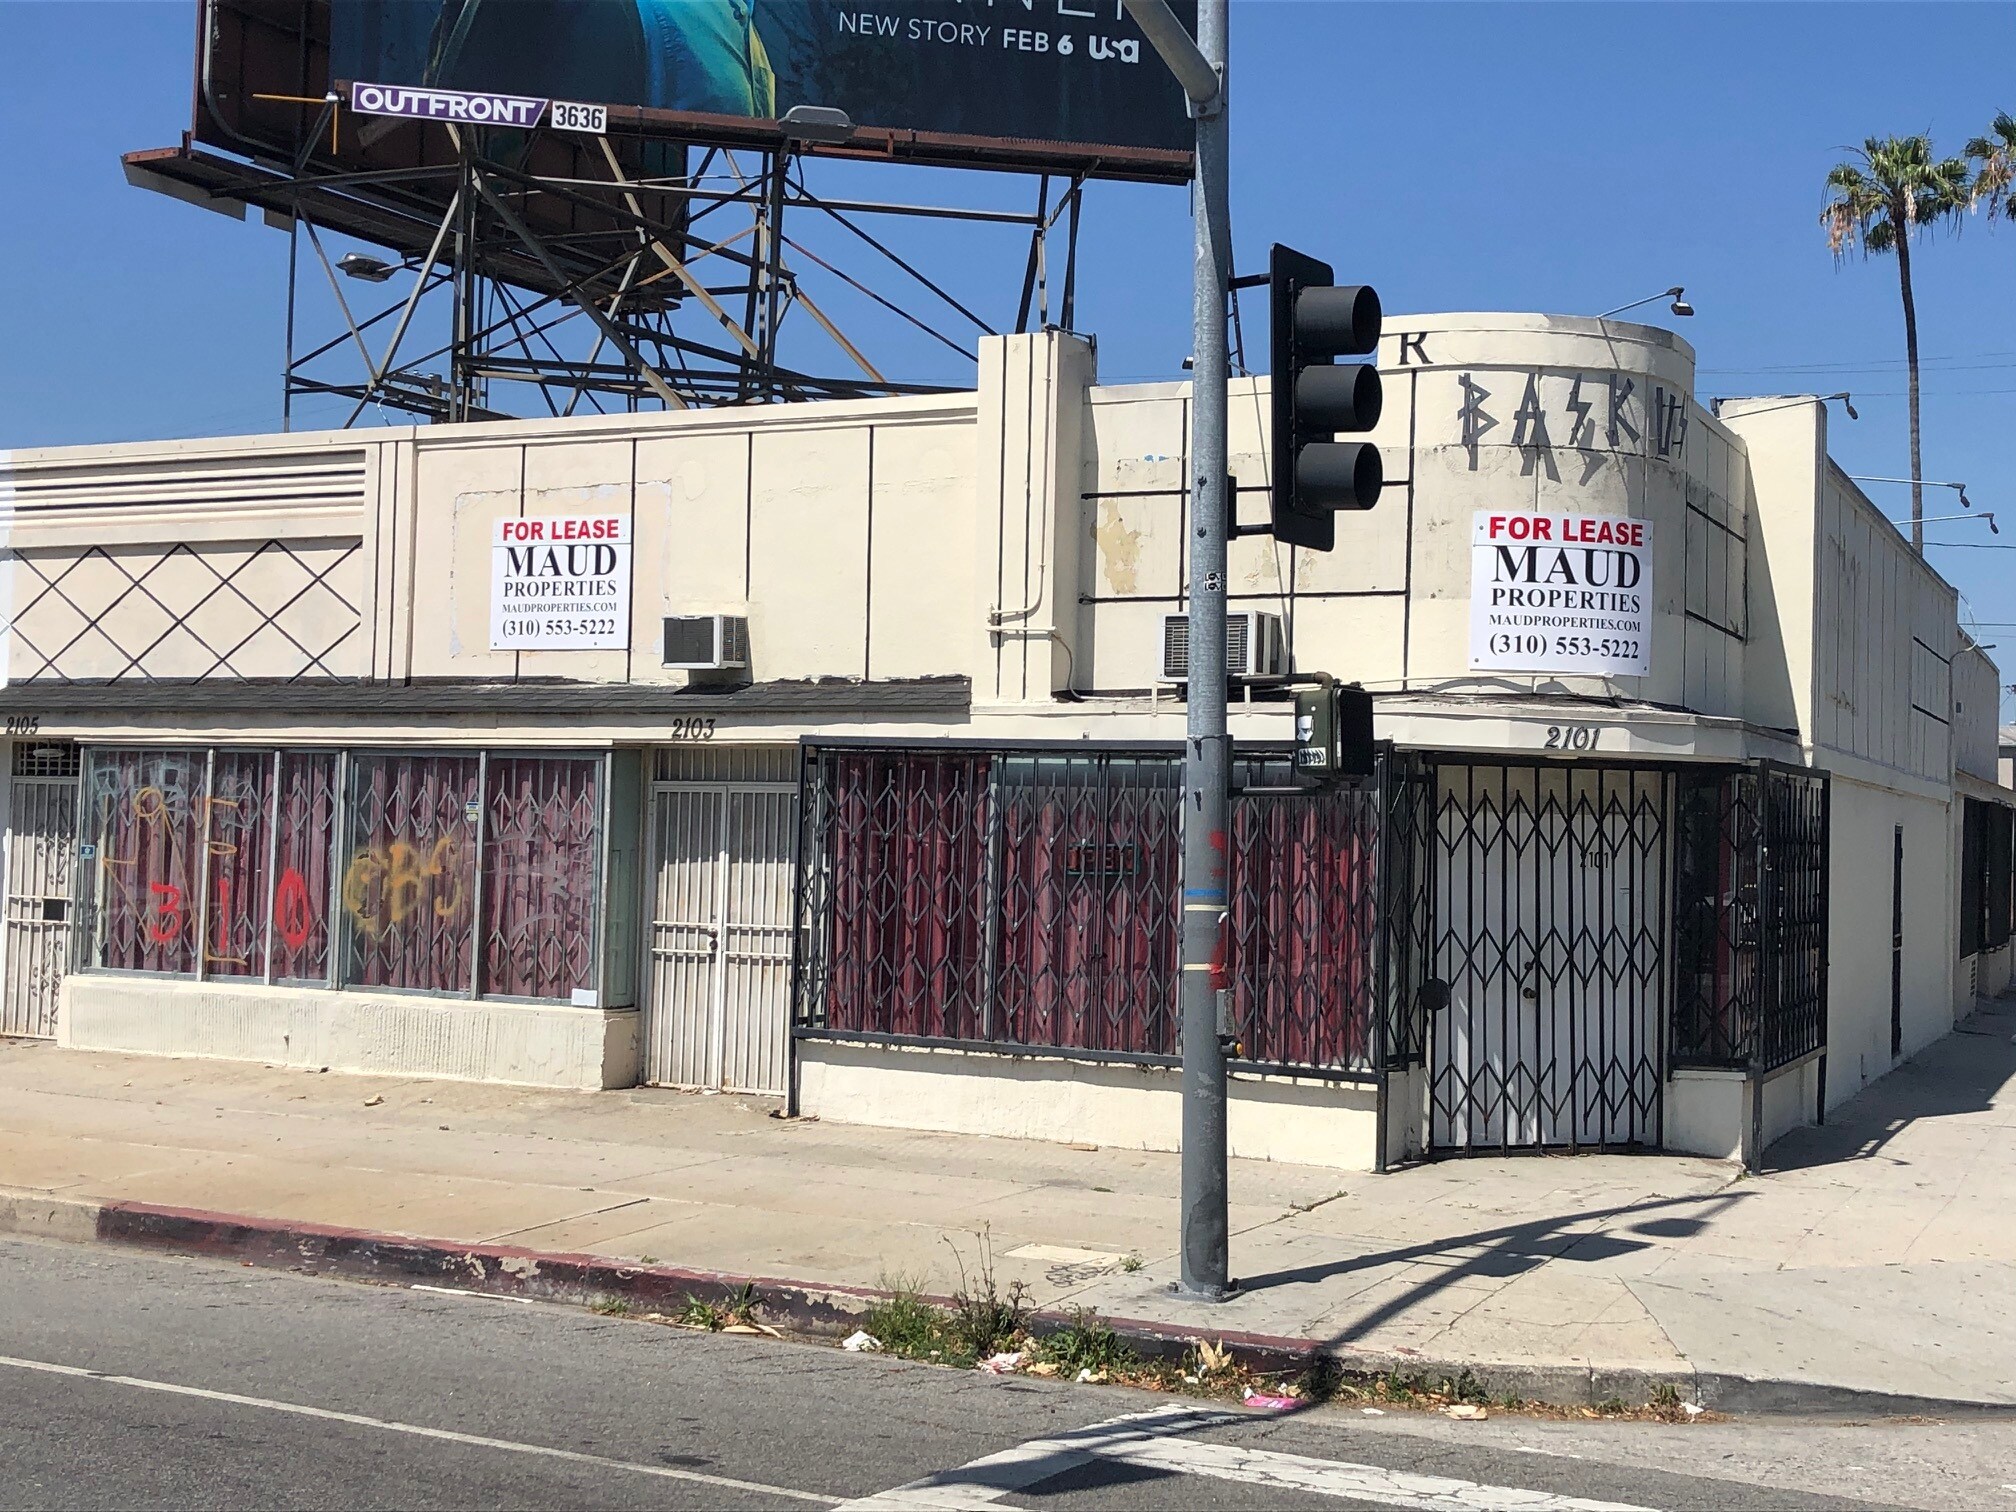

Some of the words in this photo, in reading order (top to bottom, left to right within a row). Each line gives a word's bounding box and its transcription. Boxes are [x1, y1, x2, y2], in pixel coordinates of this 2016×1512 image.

[839, 11, 899, 37] NEW
[908, 18, 991, 46] STORY
[1003, 28, 1049, 52] FEB
[1057, 35, 1074, 55] 6
[360, 87, 536, 124] OUTFRONT
[555, 104, 603, 130] 3636
[503, 521, 544, 541] FOR
[551, 519, 619, 540] LEASE
[1489, 516, 1551, 541] FOR
[1562, 518, 1643, 547] LEASE
[504, 544, 617, 578] MAUD
[1491, 545, 1641, 588] MAUD
[504, 580, 617, 598] PROPERTIES
[1491, 587, 1641, 614] PROPERTIES
[502, 602, 617, 614] MAUDPROPERTIES.COM
[502, 618, 540, 639] (310)
[546, 619, 615, 636] 553-5222
[1489, 613, 1641, 633] MAUDPROPERTIES.COM
[1489, 633, 1548, 658] (310)
[1556, 636, 1639, 659] 553-5222
[6, 715, 39, 735] 2105
[672, 717, 716, 741] 2103
[1544, 726, 1600, 750] 2101
[1580, 851, 1609, 868] 101
